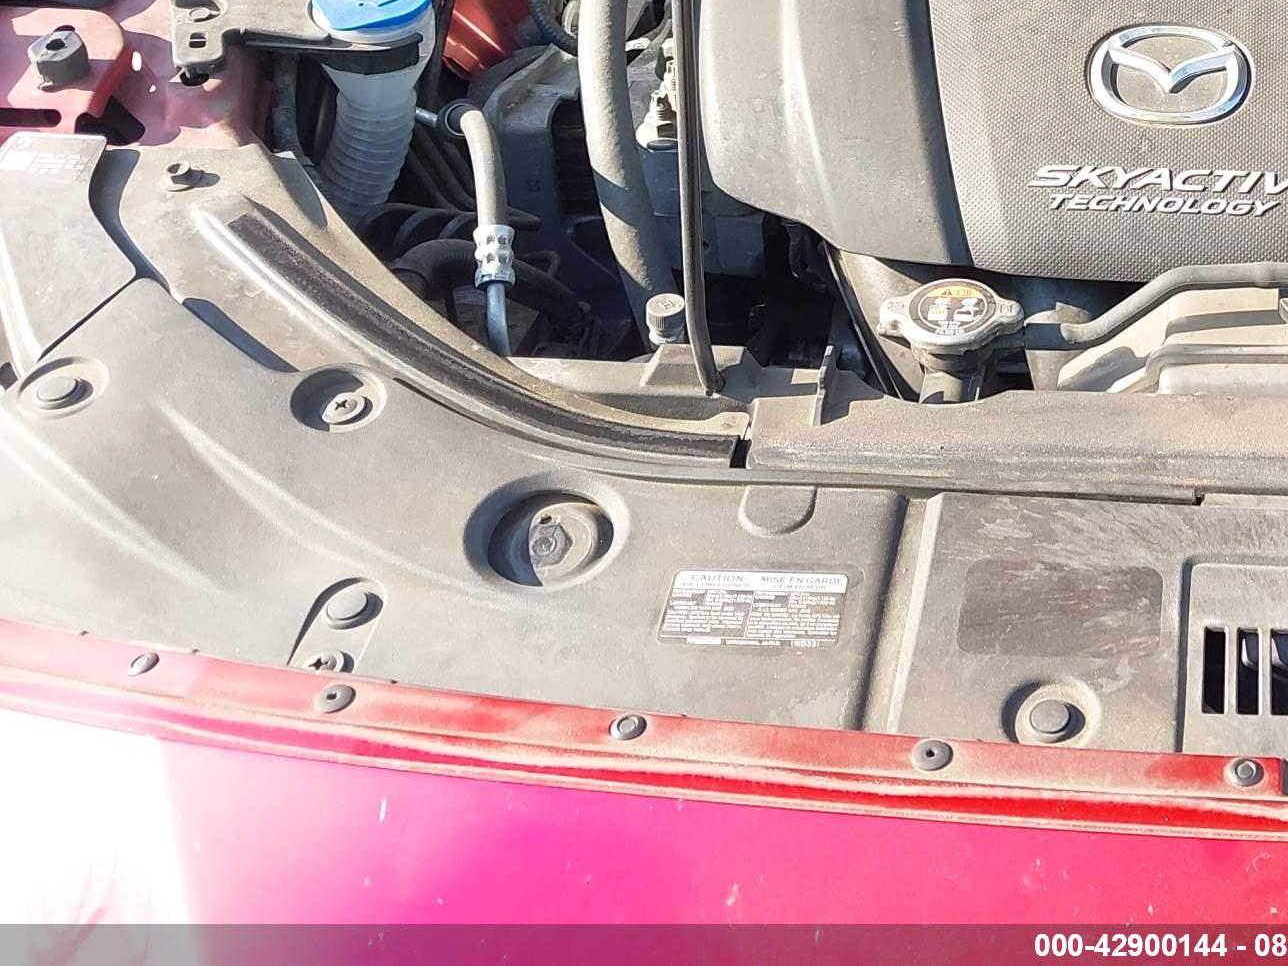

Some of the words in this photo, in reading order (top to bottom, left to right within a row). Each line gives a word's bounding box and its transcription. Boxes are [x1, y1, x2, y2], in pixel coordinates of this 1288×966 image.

[1049, 193, 1281, 217] TECHNOLOGY
[691, 574, 744, 583] CAUTION
[760, 576, 785, 584] MISE
[789, 577, 804, 585] EN
